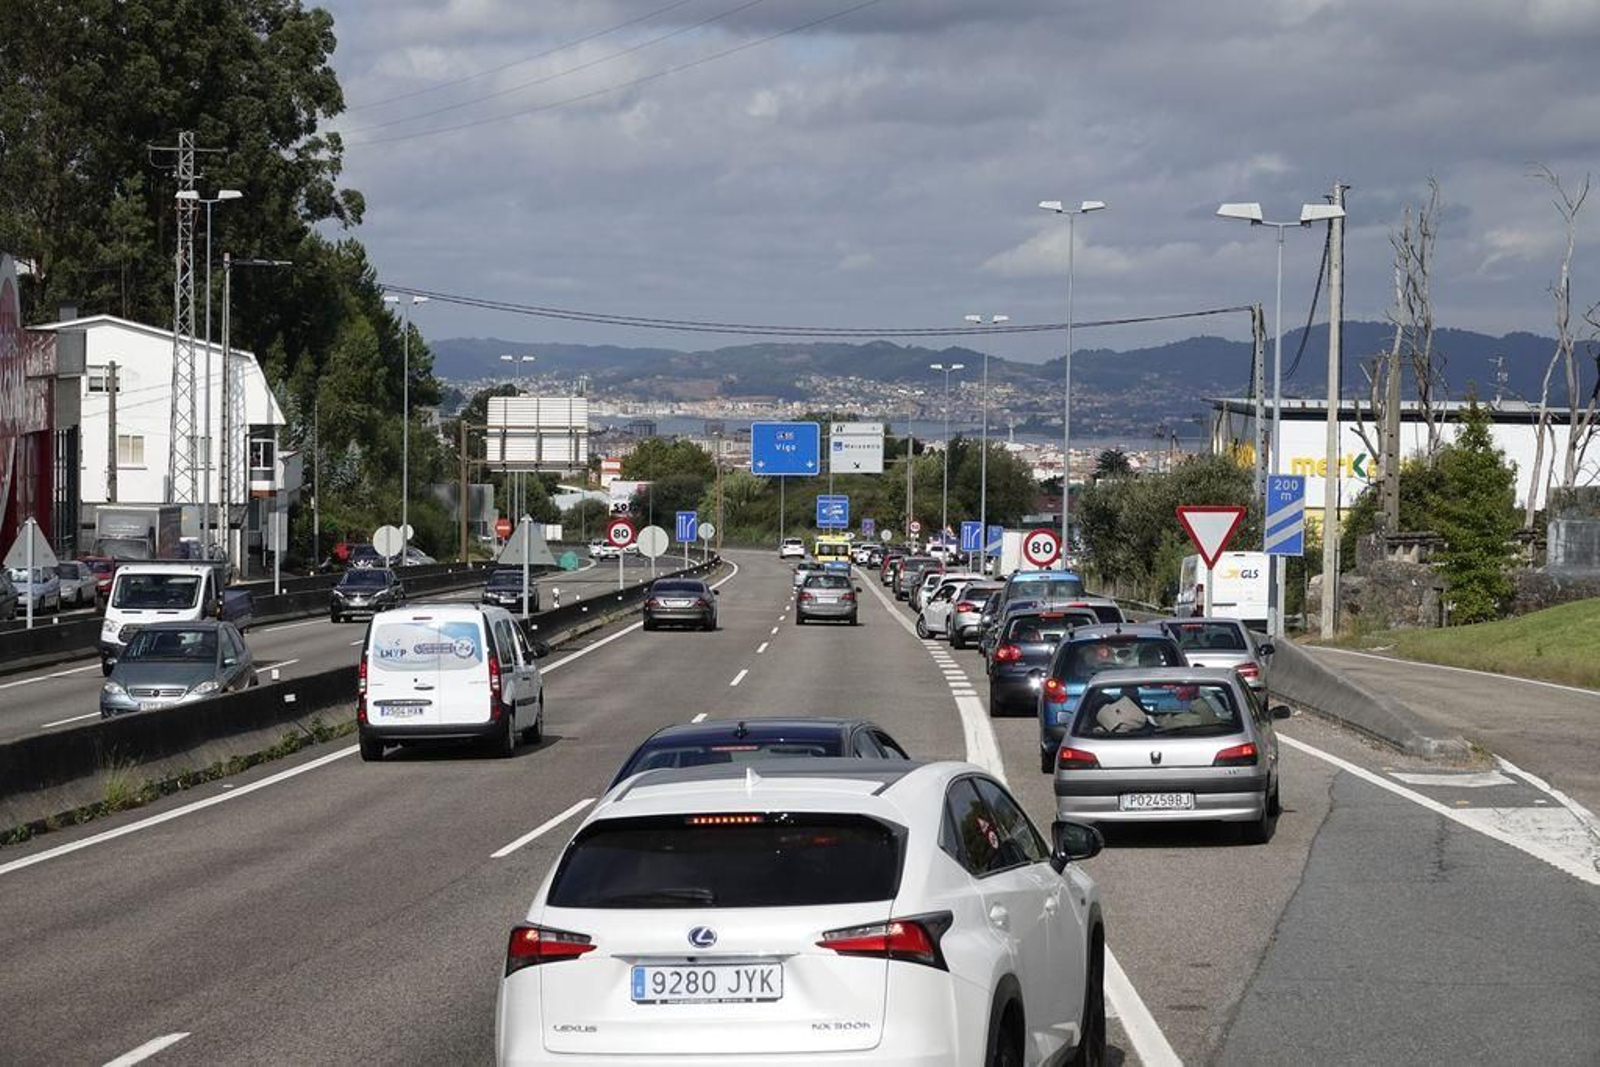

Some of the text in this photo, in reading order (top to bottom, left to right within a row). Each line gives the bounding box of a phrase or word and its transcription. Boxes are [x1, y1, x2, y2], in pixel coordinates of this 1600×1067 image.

[775, 444, 796, 452] Vigo
[1274, 479, 1298, 491] 200
[1280, 492, 1292, 501] m
[613, 528, 629, 539] 80
[1031, 541, 1053, 554] 80
[1240, 569, 1259, 579] GLS
[651, 969, 775, 995] 9280 JYK
[553, 1024, 598, 1033] LEXUS
